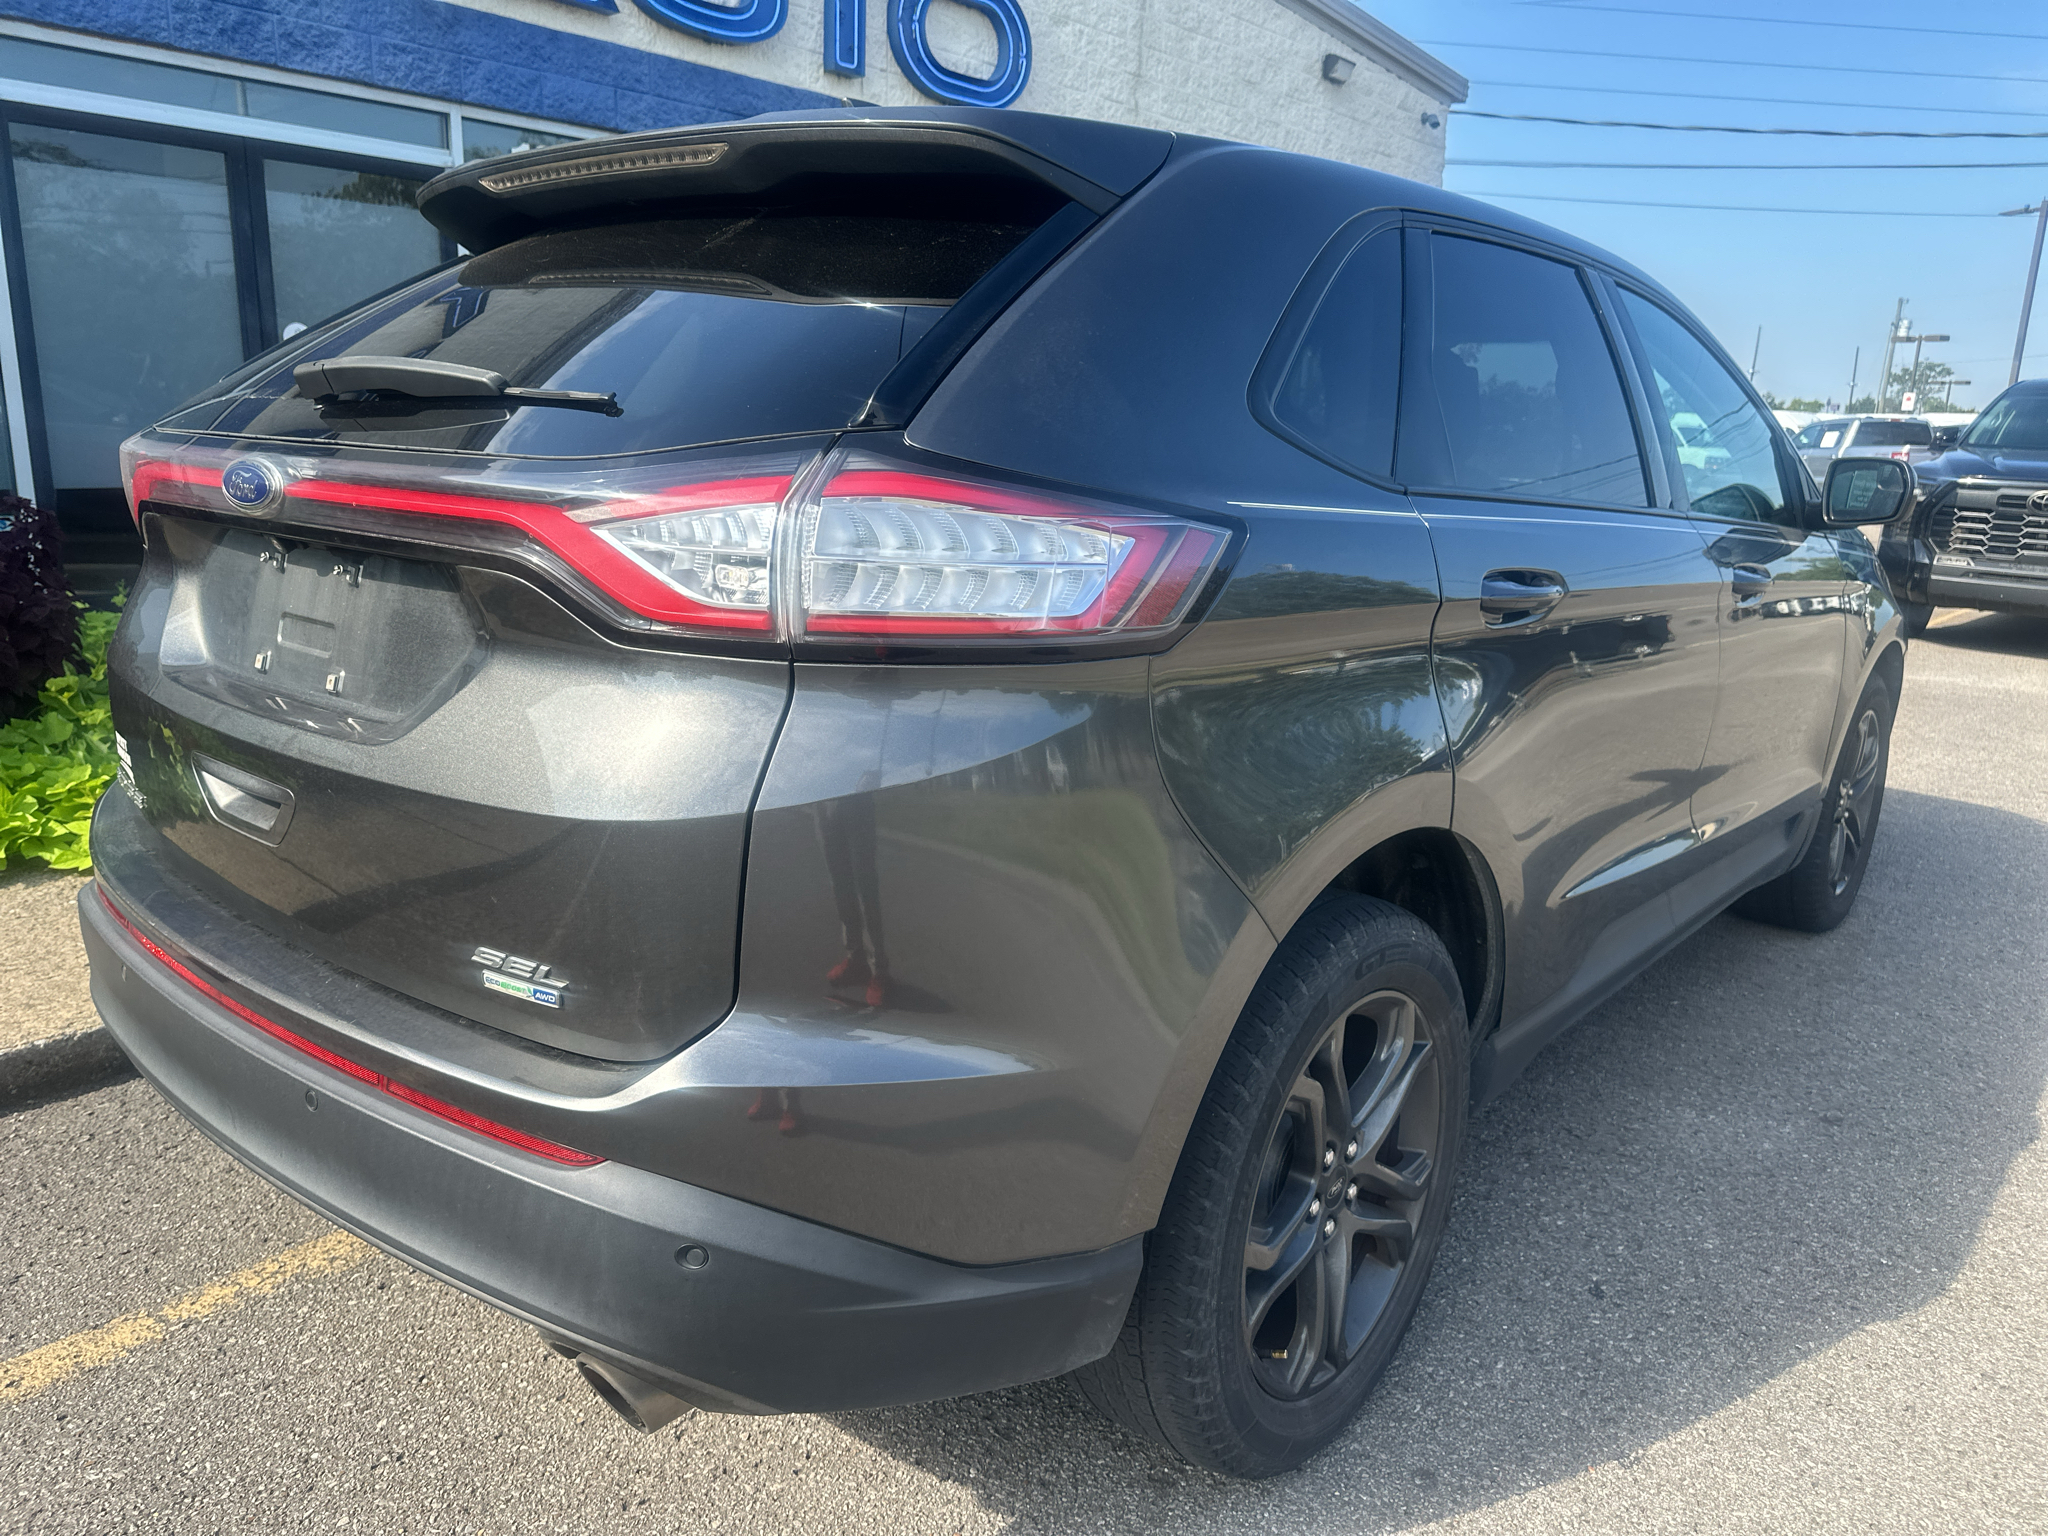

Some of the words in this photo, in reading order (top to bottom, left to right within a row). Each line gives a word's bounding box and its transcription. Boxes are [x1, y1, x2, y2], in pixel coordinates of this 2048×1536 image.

[229, 470, 258, 499] Ford
[471, 946, 569, 989] SEL
[535, 992, 556, 1003] AWD
